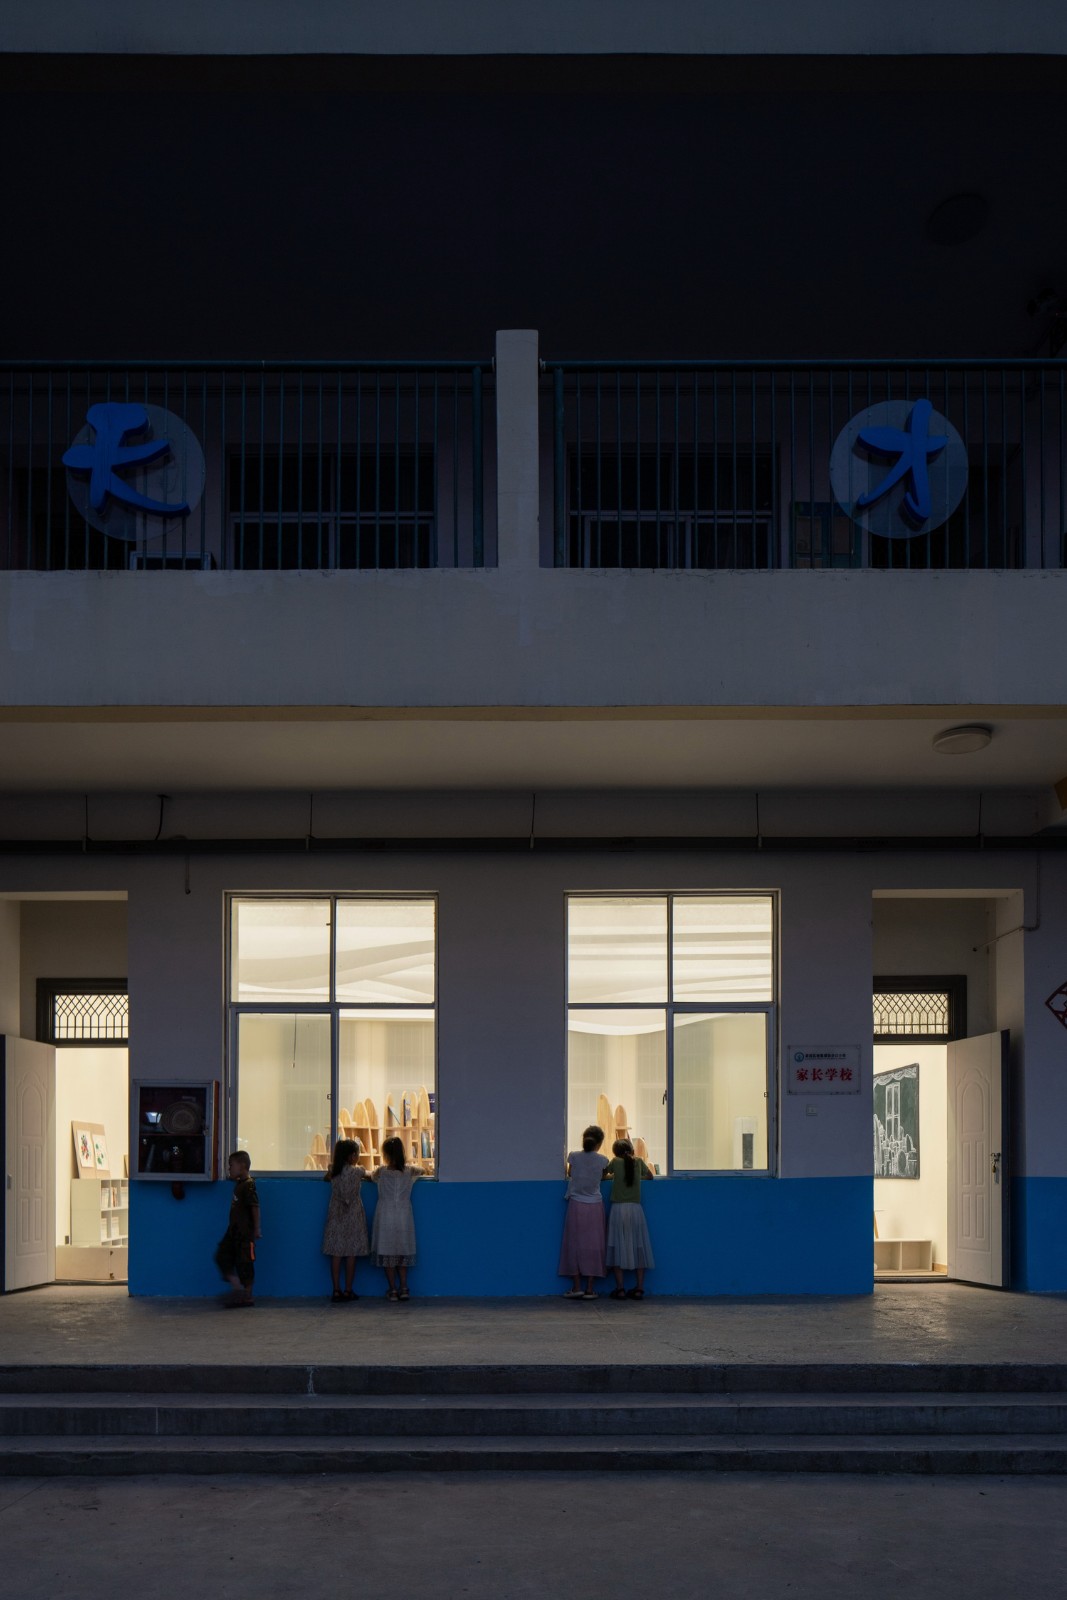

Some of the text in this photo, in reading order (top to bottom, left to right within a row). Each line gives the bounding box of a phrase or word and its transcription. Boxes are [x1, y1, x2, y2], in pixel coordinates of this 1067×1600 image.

[857, 398, 949, 523] 才
[797, 1067, 853, 1081] 家长学校
